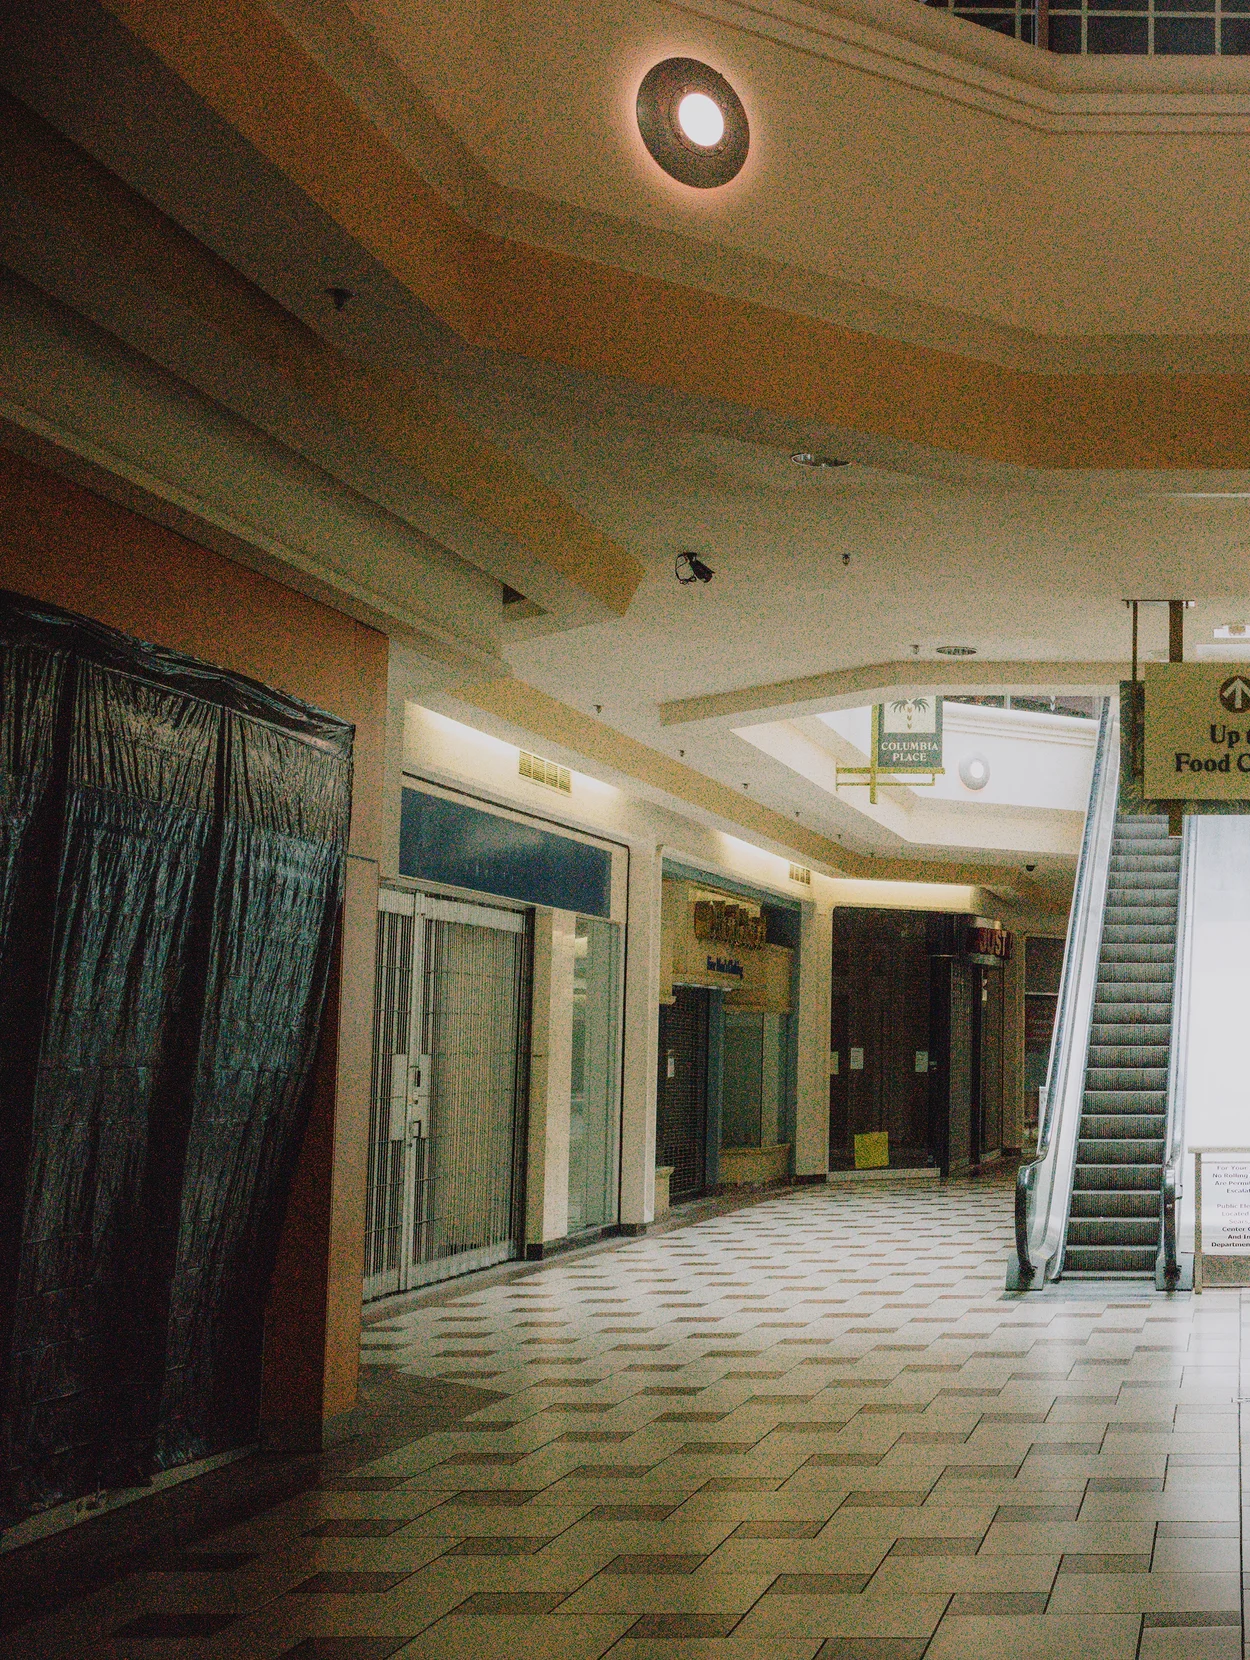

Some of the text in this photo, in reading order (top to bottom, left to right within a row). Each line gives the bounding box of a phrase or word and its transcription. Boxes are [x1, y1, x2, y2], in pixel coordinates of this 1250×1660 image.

[1210, 724, 1241, 748] Up
[881, 742, 938, 751] COLUMBIA
[893, 753, 927, 761] PLACE
[1175, 753, 1230, 773] Food
